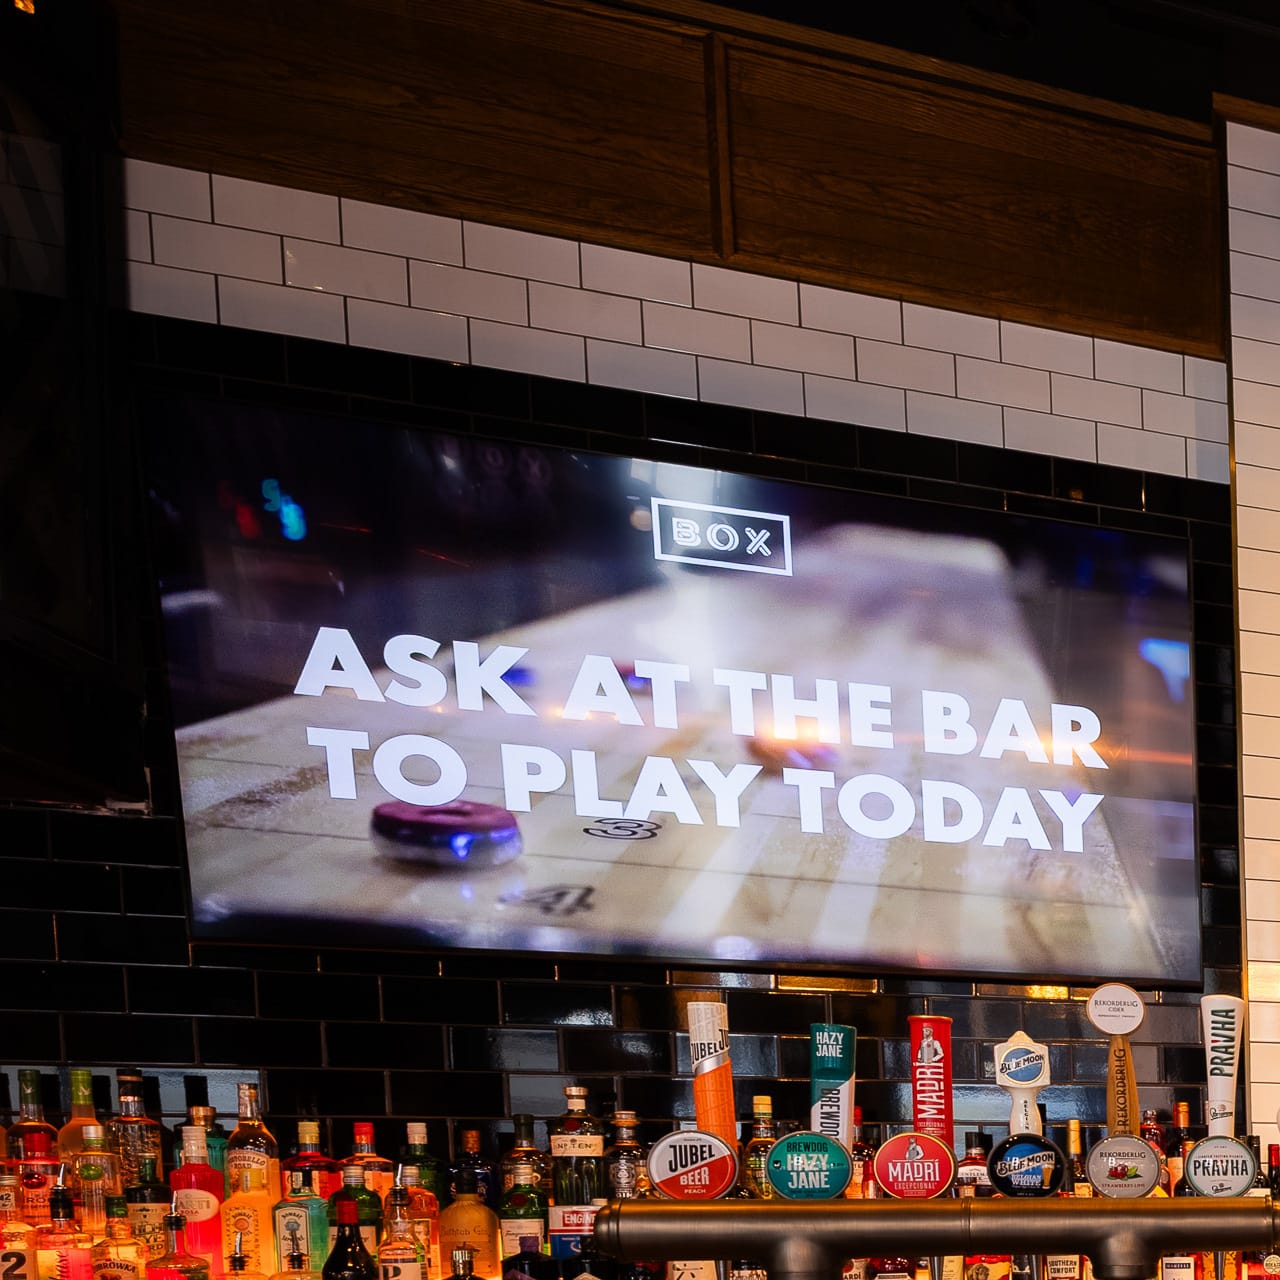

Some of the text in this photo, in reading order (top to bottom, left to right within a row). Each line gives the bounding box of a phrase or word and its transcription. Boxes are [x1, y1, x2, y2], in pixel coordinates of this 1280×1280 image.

[671, 516, 772, 557] BOX
[293, 627, 1109, 769] ASK AT THE BAR
[306, 726, 1105, 853] TO PLAY TODAY
[1094, 1000, 1138, 1008] REKORDERLIG
[816, 1031, 844, 1045] HAZY
[1210, 1008, 1236, 1077] PRAVHA
[690, 1041, 725, 1065] JUBEL
[816, 1045, 843, 1058] JANE
[1000, 1053, 1045, 1074] BLUE MOON
[913, 1062, 945, 1120] MADRÍ
[1114, 1048, 1127, 1127] REKORDERLIG
[820, 1088, 841, 1141] BREWDO
[787, 1142, 829, 1152] BREWDOG
[1100, 1151, 1146, 1159] REKORDERLIG
[668, 1144, 715, 1173] JUBEL
[787, 1153, 829, 1171] HAZY
[997, 1152, 1055, 1177] BLUE MOON
[1193, 1158, 1249, 1176] PRAVHA
[680, 1167, 709, 1185] BEER
[788, 1172, 830, 1188] JANE
[888, 1159, 941, 1183] MADRÍ
[564, 1212, 597, 1224] ENGIN
[1050, 1266, 1076, 1274] COMFORT
